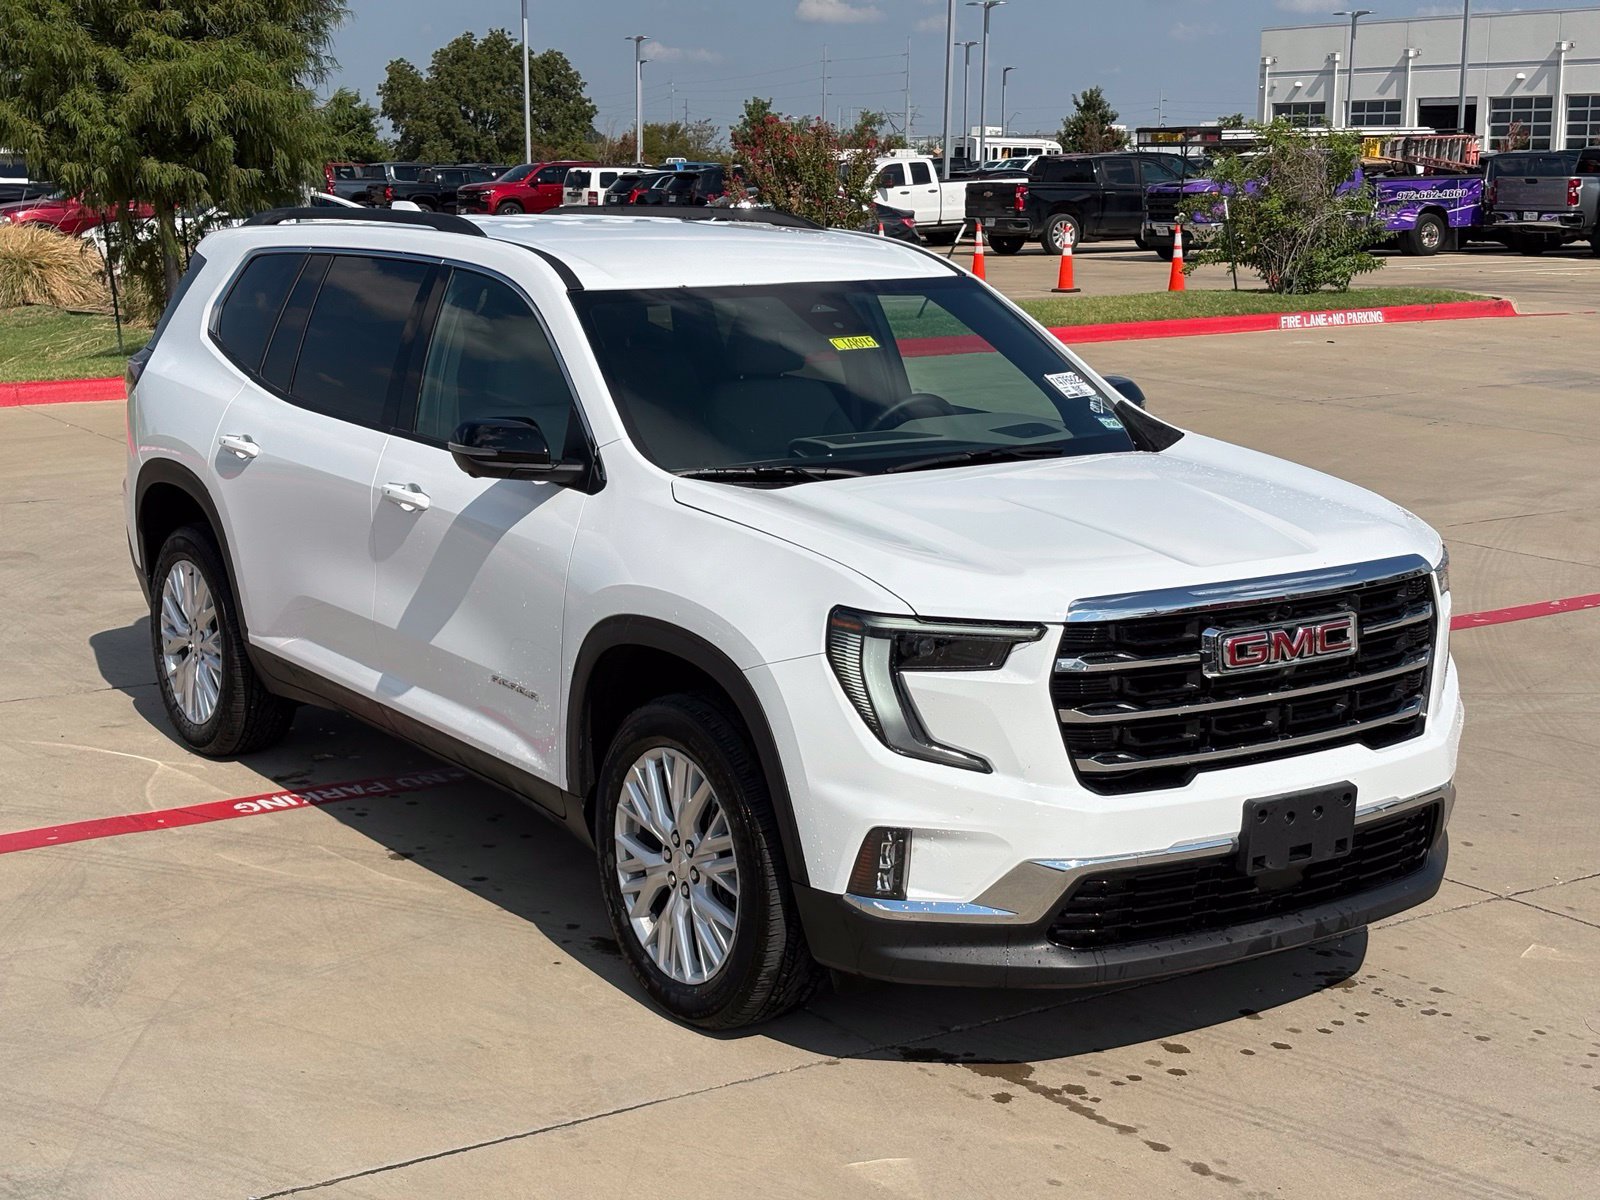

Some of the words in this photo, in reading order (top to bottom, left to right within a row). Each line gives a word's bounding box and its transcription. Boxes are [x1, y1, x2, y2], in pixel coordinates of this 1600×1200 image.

[1397, 189, 1468, 201] 972-682-4860
[1280, 315, 1302, 329] FIRE
[1303, 314, 1328, 327] LANE
[1332, 313, 1345, 325] NO
[1346, 311, 1384, 324] PARKING
[1224, 620, 1352, 668] GMC
[233, 781, 392, 813] PARKING
